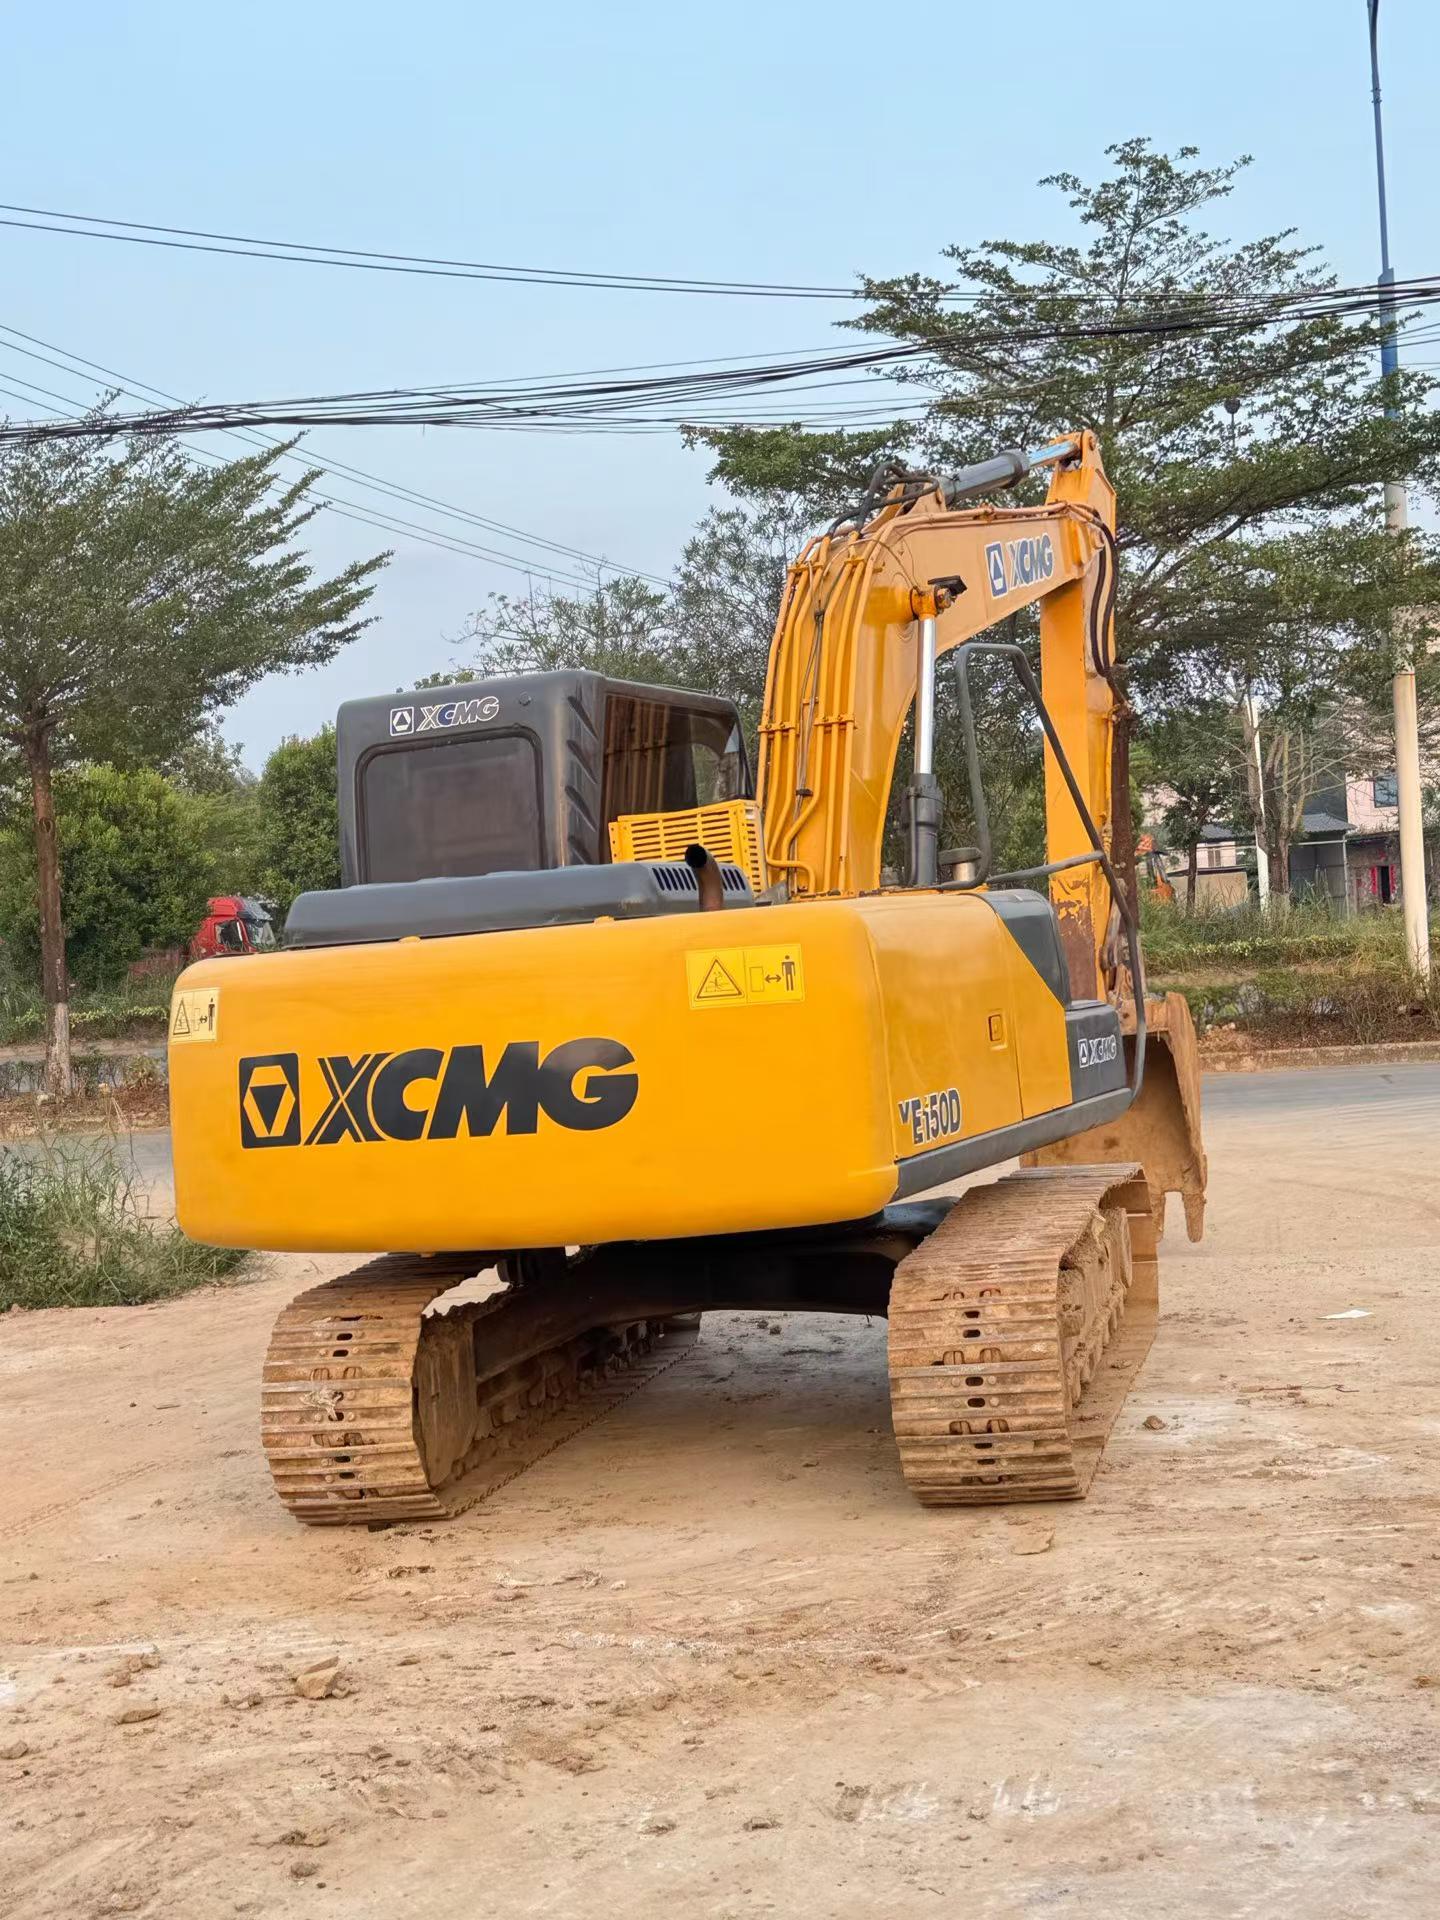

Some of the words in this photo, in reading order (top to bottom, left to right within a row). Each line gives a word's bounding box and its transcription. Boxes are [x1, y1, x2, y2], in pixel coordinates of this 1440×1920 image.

[1005, 532, 1054, 591] XCMG
[416, 696, 500, 732] XCMG
[1089, 1034, 1117, 1066] XCMG
[303, 1037, 640, 1147] XCMG
